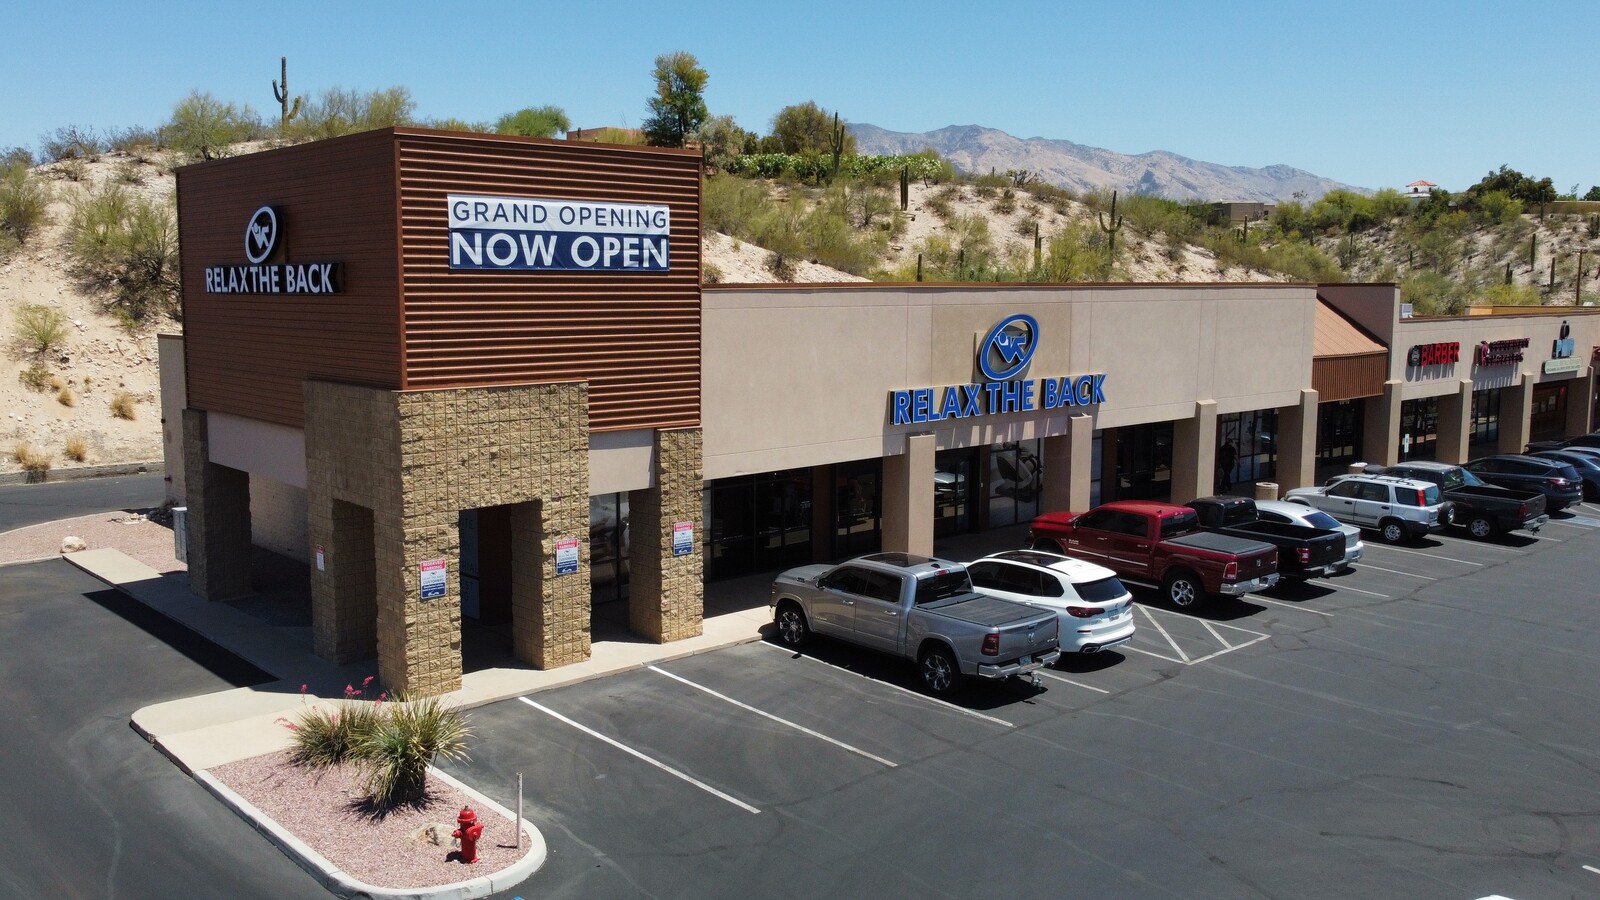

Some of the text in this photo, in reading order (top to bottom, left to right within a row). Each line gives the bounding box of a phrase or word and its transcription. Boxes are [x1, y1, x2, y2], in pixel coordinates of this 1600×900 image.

[452, 200, 667, 229] GRAND OPENING
[451, 232, 667, 268] NOW OPEN
[205, 263, 334, 294] RELAX THE BACK
[1421, 341, 1460, 366] BARBER
[892, 373, 1108, 426] RELAX THE BACK
